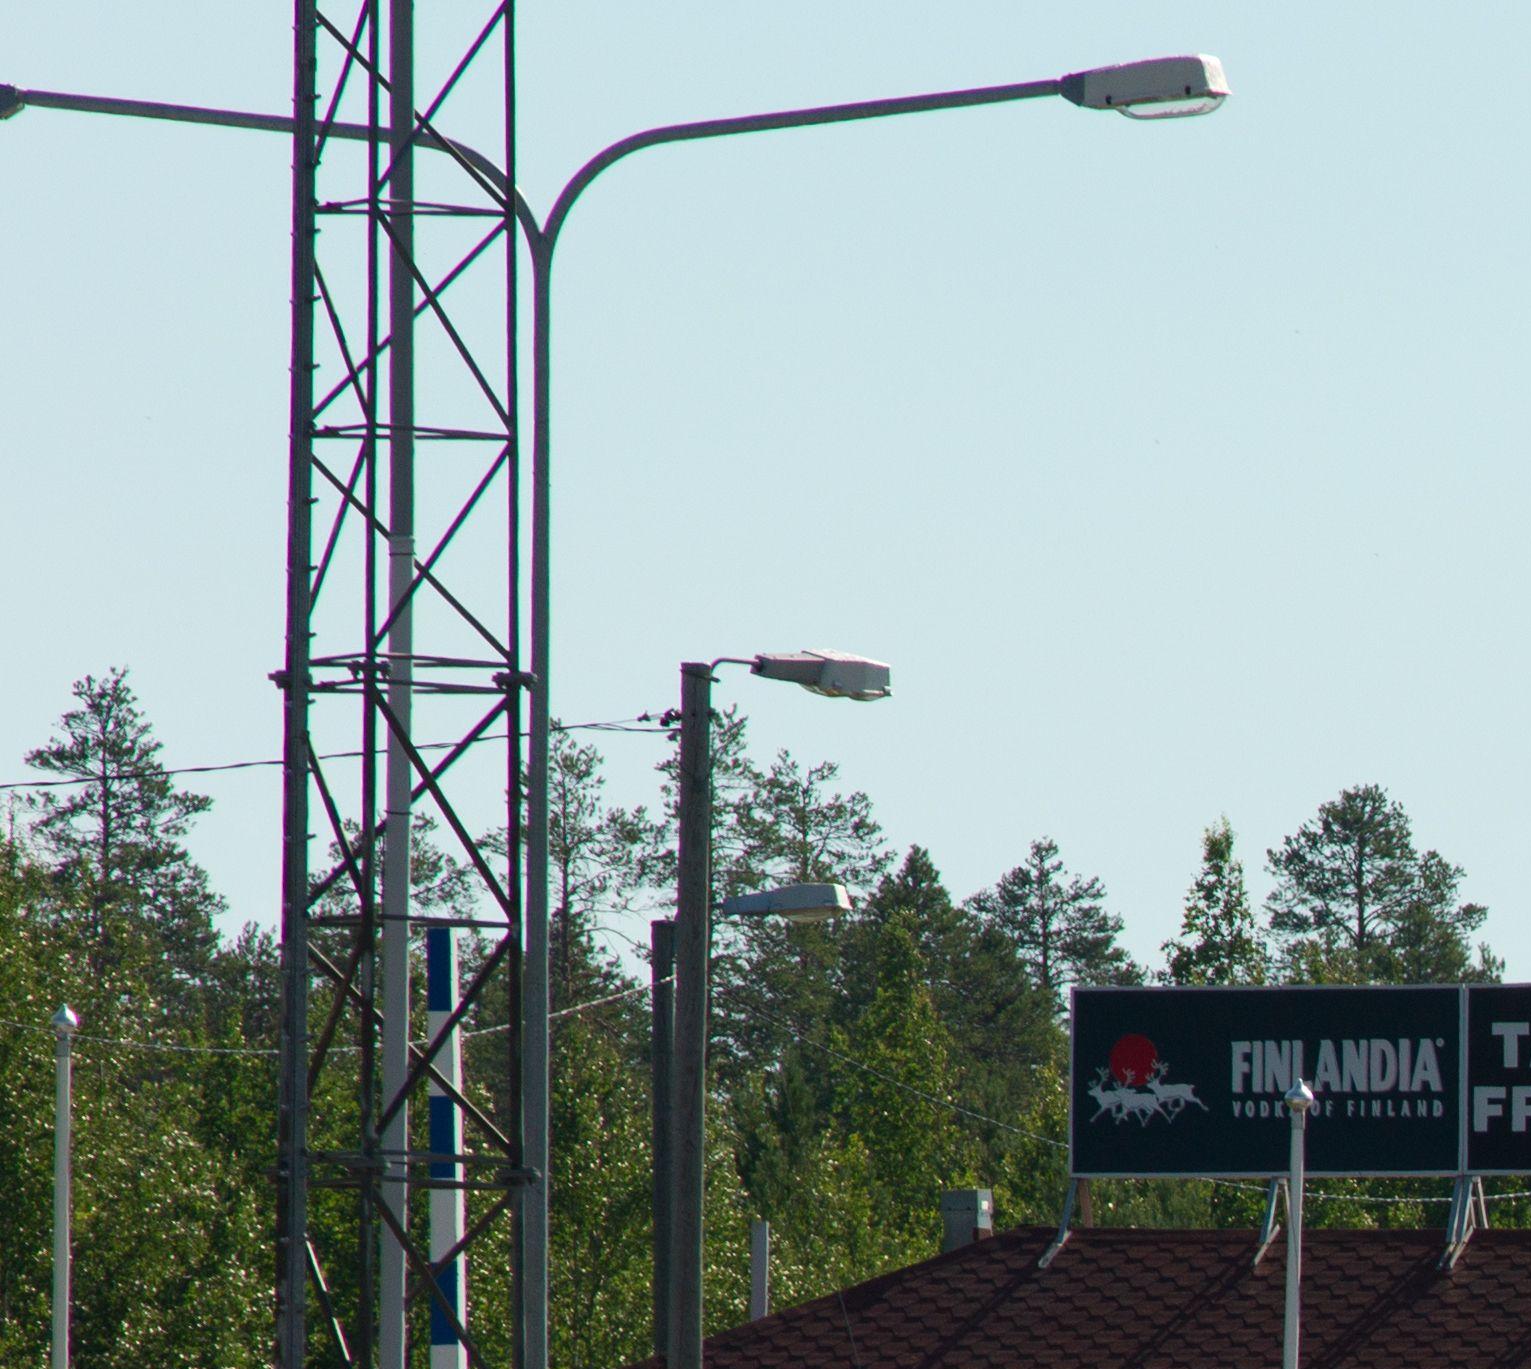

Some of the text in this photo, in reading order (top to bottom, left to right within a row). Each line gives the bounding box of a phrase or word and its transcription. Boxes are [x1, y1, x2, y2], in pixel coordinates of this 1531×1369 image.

[1231, 1038, 1443, 1092] FINLANDIA
[1232, 1099, 1444, 1118] VODK OF FINLAND
